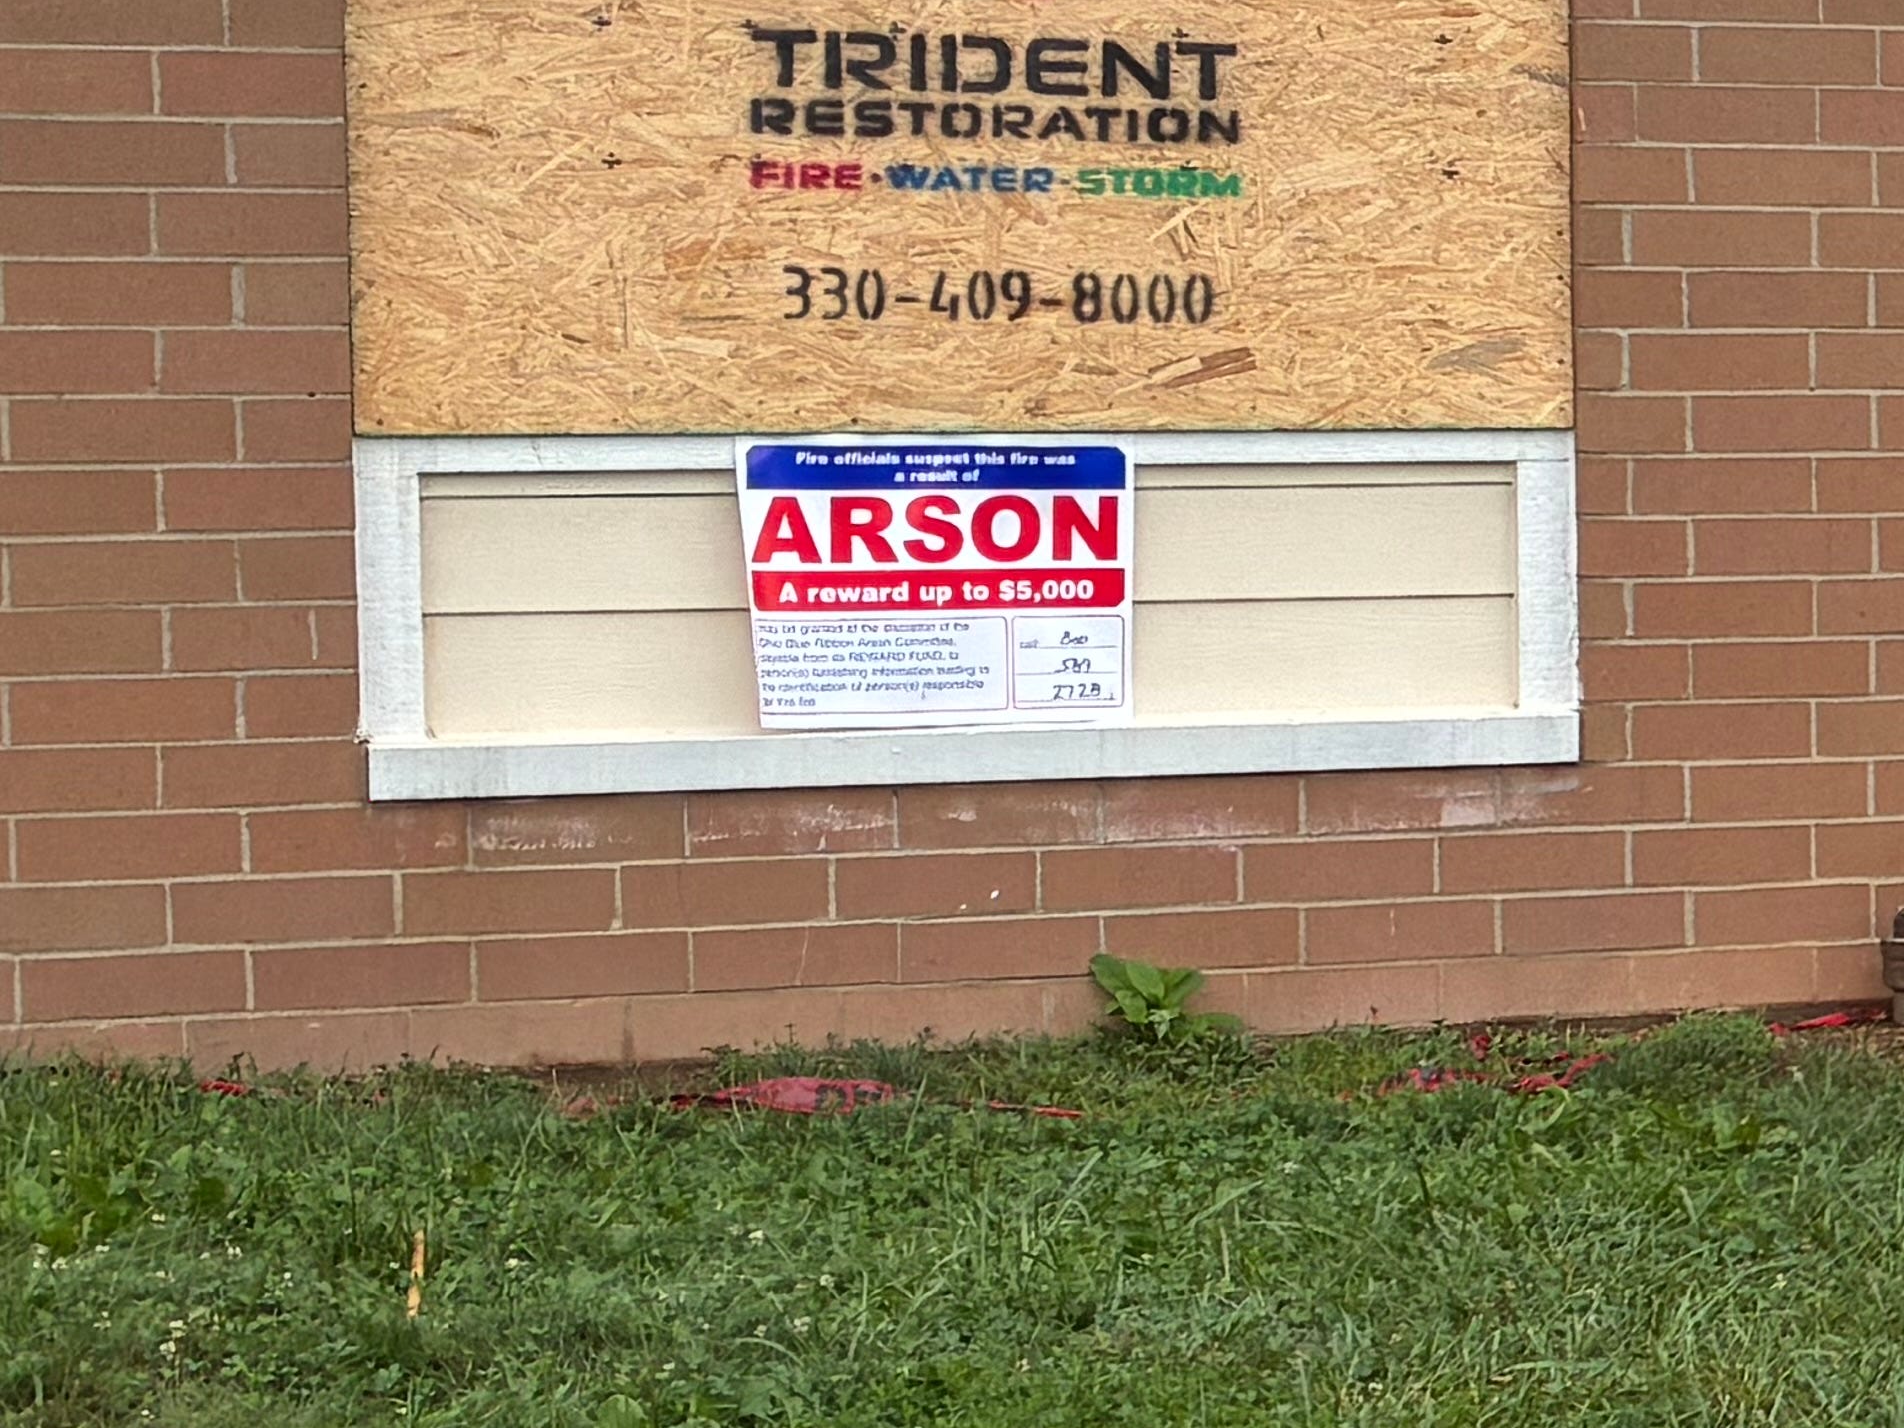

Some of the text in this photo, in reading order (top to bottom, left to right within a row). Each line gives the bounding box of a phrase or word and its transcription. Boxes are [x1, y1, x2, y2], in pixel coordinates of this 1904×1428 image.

[751, 29, 1238, 102] TRIDENT
[749, 98, 1241, 145] RESTORATION
[749, 160, 1241, 198] FIRE WATER STORM
[782, 266, 1215, 324] 330-409-8000
[795, 452, 829, 465] Fire
[834, 452, 900, 465] officials
[974, 452, 1006, 465] this
[1043, 454, 1076, 465] was
[909, 469, 959, 482] result
[961, 469, 981, 482] of
[751, 494, 1119, 564] ARSON
[779, 579, 1094, 606] A reward up to $5,000
